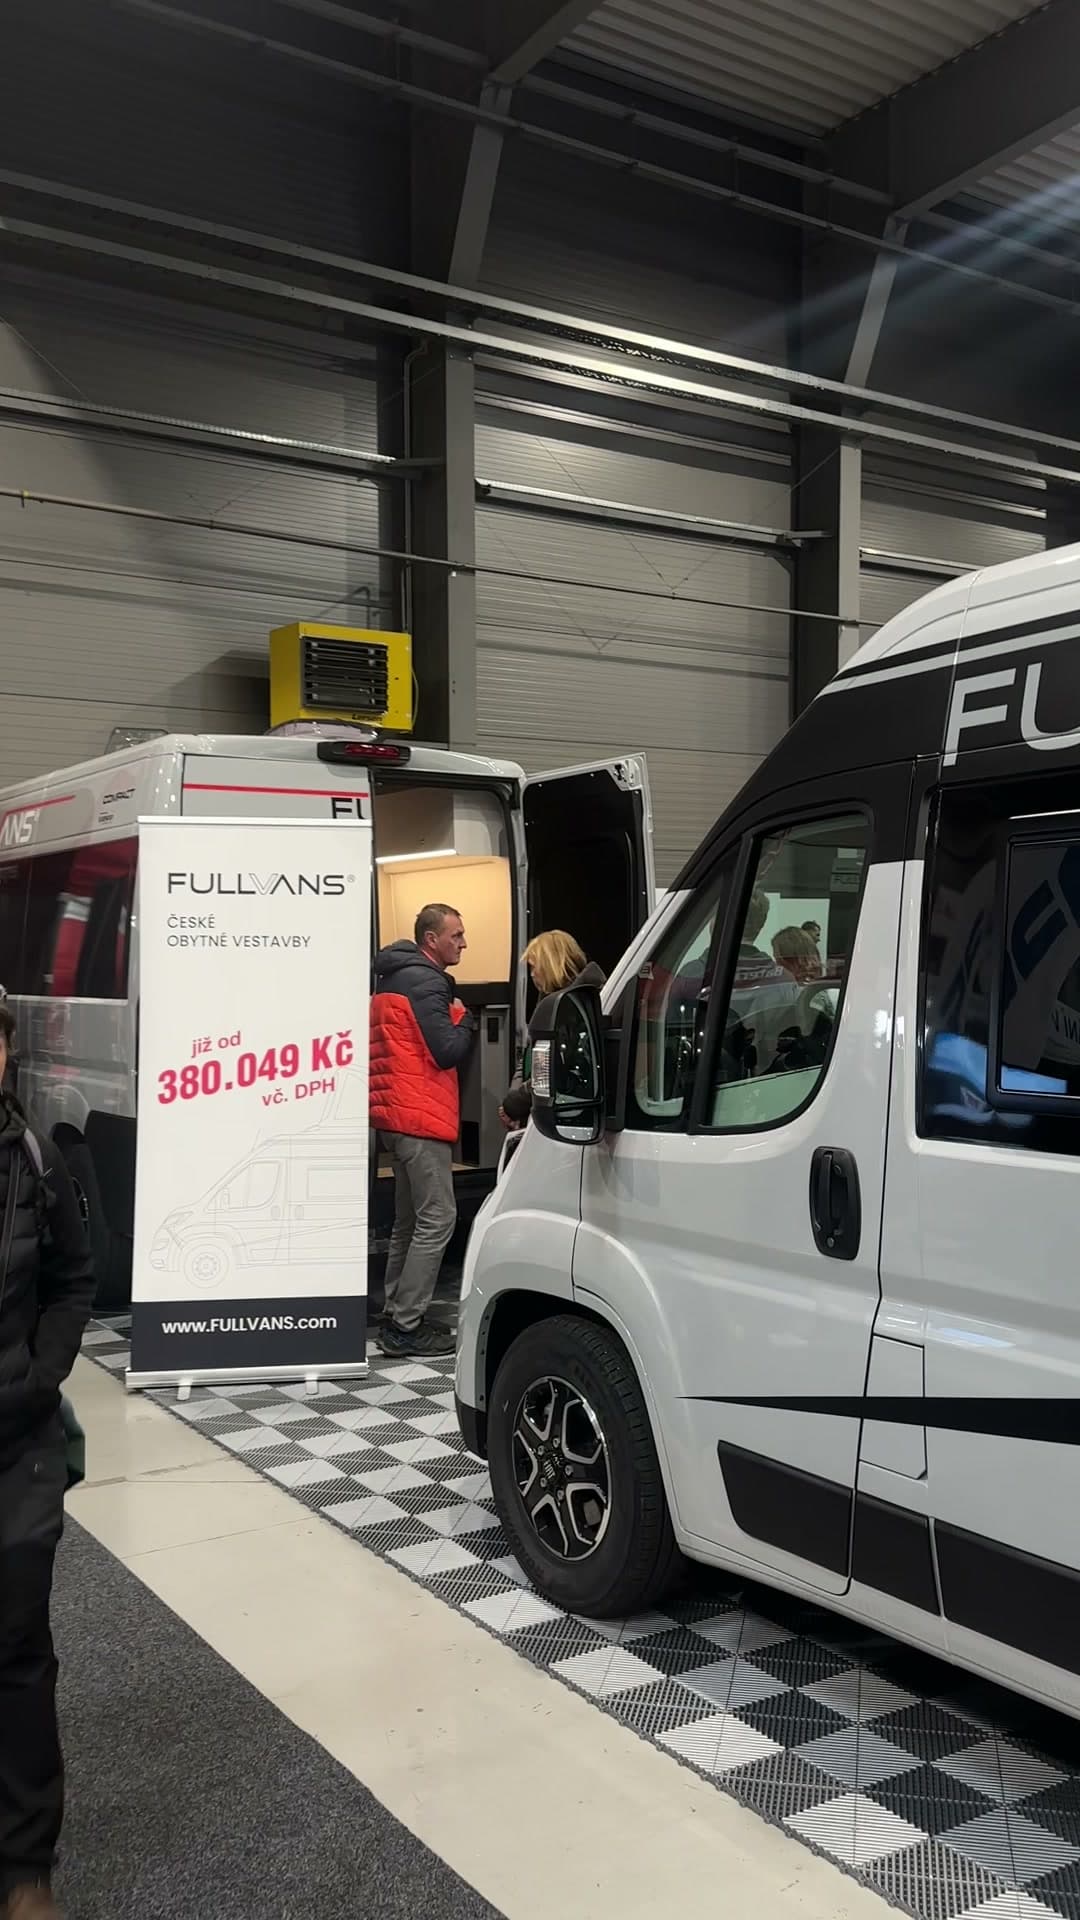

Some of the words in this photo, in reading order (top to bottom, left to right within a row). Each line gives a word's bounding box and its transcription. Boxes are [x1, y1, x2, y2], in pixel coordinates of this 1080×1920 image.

[167, 913, 216, 929] ČESKÉ
[167, 932, 228, 948] OBYTNÉ
[232, 935, 312, 948] VESTAVBY
[191, 1036, 213, 1058] již
[217, 1030, 242, 1050] od
[157, 1043, 300, 1105] 380.049
[311, 1029, 354, 1072] Kč
[261, 1087, 289, 1107] vč.
[294, 1076, 336, 1100] DPH
[161, 1315, 338, 1334] www.FULLVANS.com
